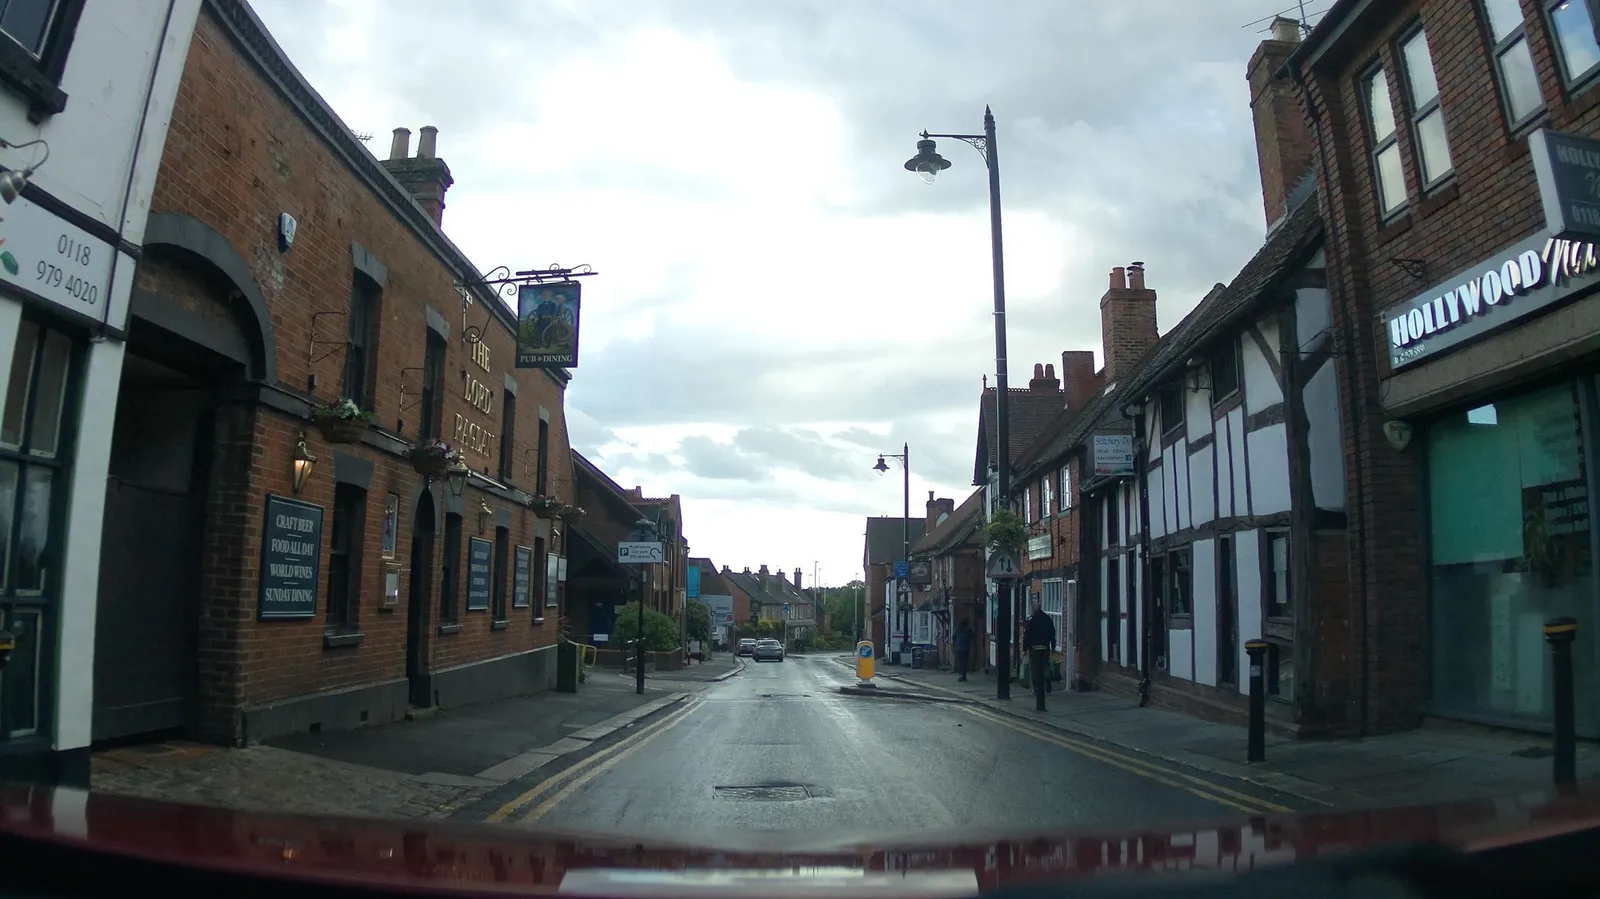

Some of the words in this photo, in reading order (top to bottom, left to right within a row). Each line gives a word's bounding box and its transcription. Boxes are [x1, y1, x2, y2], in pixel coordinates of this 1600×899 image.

[57, 234, 91, 266] 0118
[36, 260, 63, 288] 979
[65, 275, 98, 305] 4020
[1390, 249, 1542, 349] HOLLYWOOD
[471, 334, 491, 372] THE
[520, 355, 536, 363] PUB
[543, 354, 573, 363] DINING
[464, 373, 491, 414] LORD
[276, 514, 298, 531] CRAFT
[298, 517, 314, 533] BEER
[271, 538, 289, 553] FOOD
[290, 540, 301, 555] ALL
[302, 543, 314, 556] DAY
[270, 563, 294, 578] WORLD
[294, 565, 313, 579] WINES
[265, 587, 291, 602] SUNDAY
[291, 589, 313, 603] DINING
